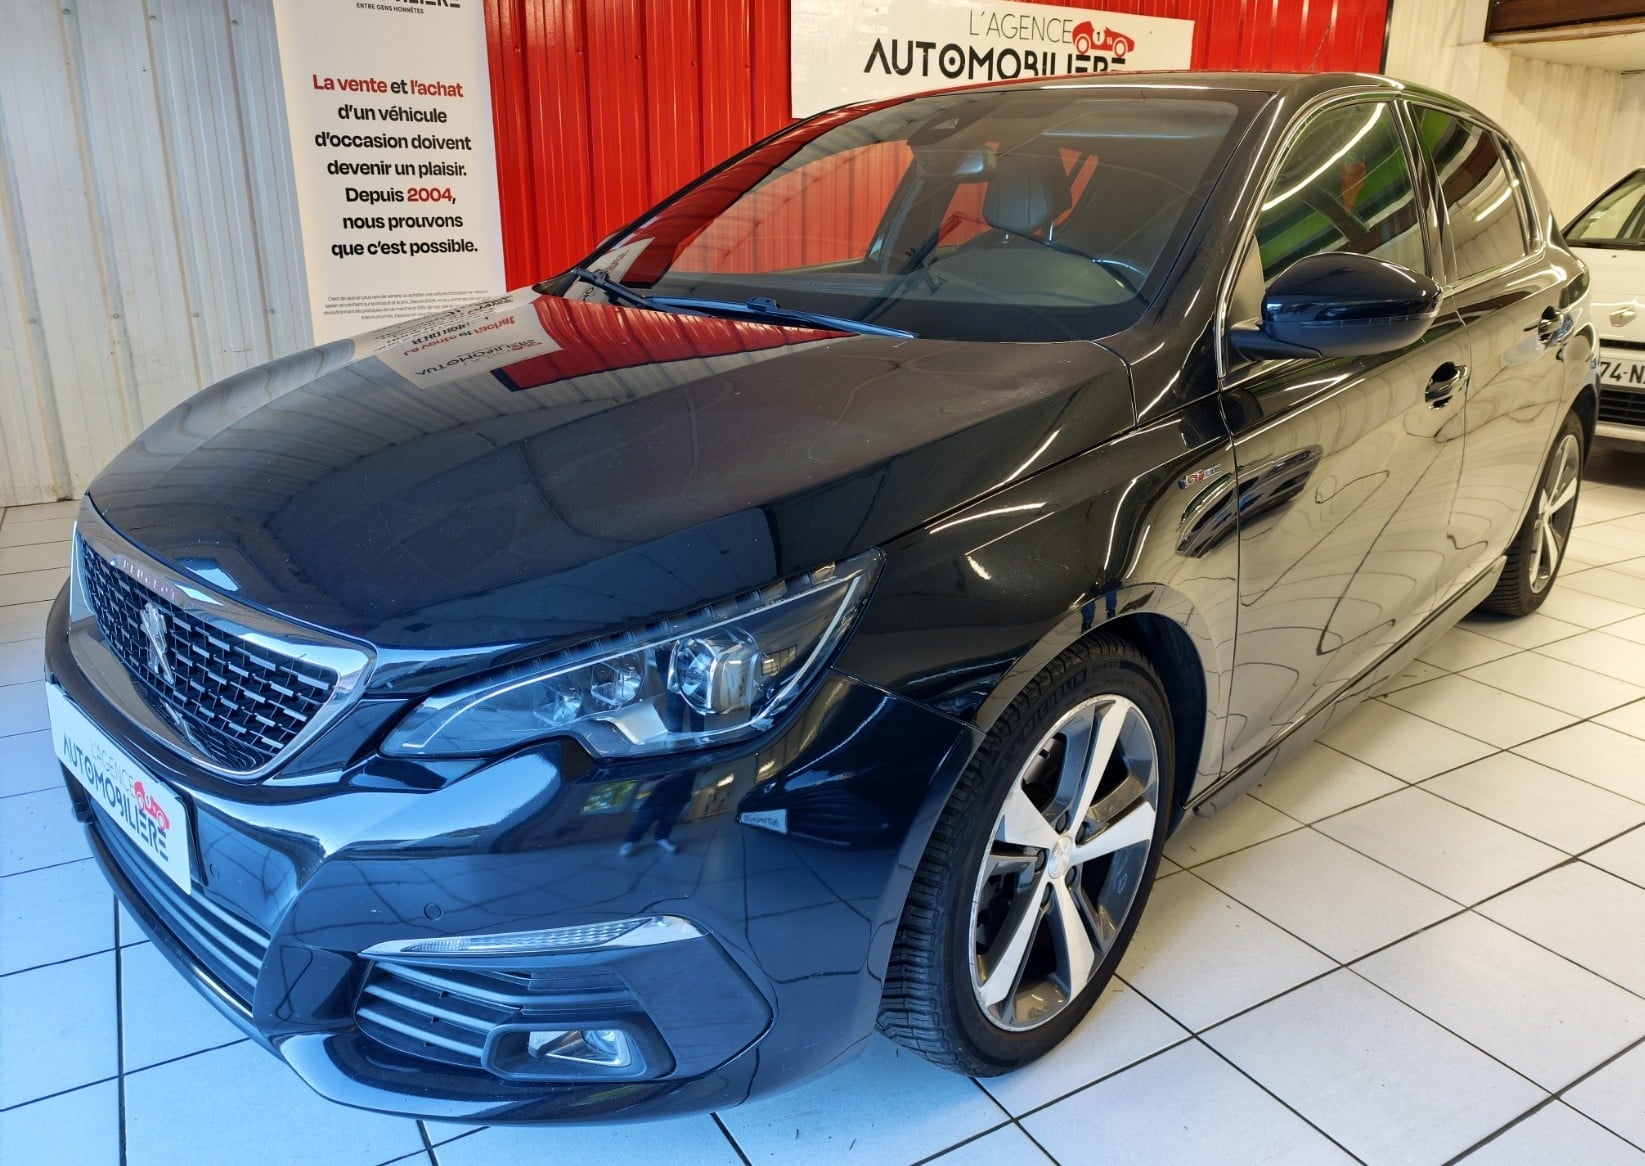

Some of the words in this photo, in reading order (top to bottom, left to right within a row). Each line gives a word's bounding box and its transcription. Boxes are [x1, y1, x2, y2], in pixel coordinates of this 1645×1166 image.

[356, 2, 376, 10] ENTRE
[376, 4, 393, 12] GENS
[393, 6, 425, 15] HONNÊTES
[969, 9, 1073, 45] L'AGENCE
[312, 74, 335, 91] La
[337, 77, 388, 93] vente
[390, 79, 408, 95] et
[410, 79, 464, 98] l'achat
[337, 104, 376, 121] d'un
[378, 105, 448, 123] véhicule
[314, 131, 409, 149] d'occasion
[411, 134, 472, 151] doivent
[326, 159, 392, 176] devenir
[394, 163, 416, 176] un
[418, 161, 468, 178] plaisir.
[345, 187, 405, 205] Depuis
[406, 187, 457, 205] 2004,
[342, 216, 386, 229] nous
[388, 215, 464, 231] prouvons
[331, 242, 365, 259] que
[367, 240, 408, 255] c'est
[409, 238, 479, 257] possible.
[1600, 361, 1645, 385] 74-N
[122, 559, 177, 601] PEUGEOT
